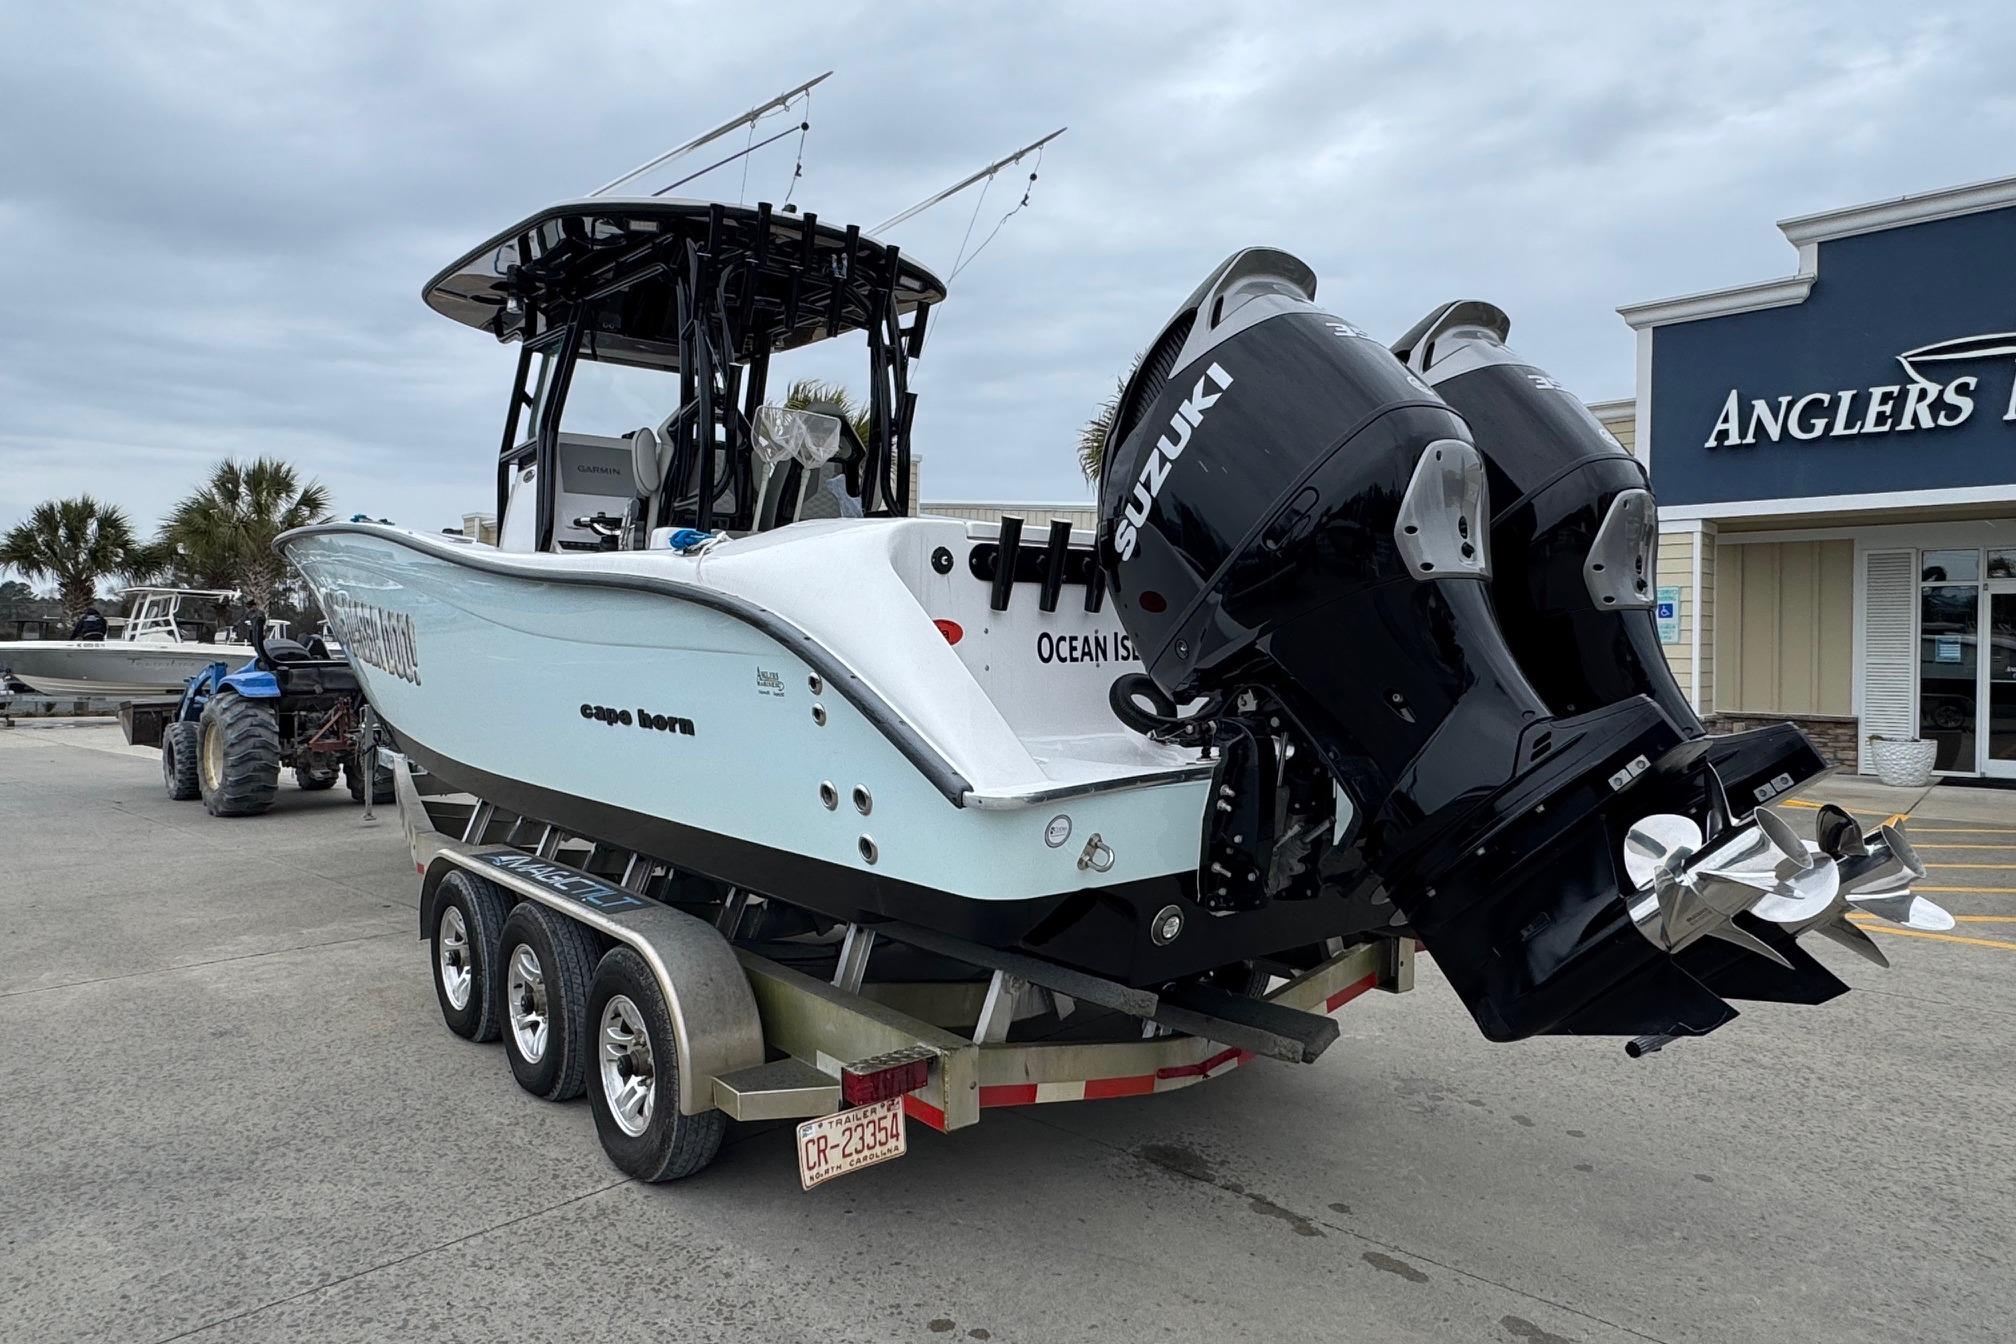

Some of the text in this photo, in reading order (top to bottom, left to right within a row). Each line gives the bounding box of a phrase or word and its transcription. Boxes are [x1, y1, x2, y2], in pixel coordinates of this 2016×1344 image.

[1704, 376, 1978, 448] ANGLERS
[577, 464, 621, 475] GARMIN
[1114, 361, 1234, 562] SUZUKI
[1037, 631, 1108, 664] OCEAN
[580, 703, 695, 736] cape horn
[828, 1106, 877, 1129] TRAILER
[805, 1112, 900, 1172] CR-23354
[809, 1145, 900, 1182] NORTH CAROLINA
